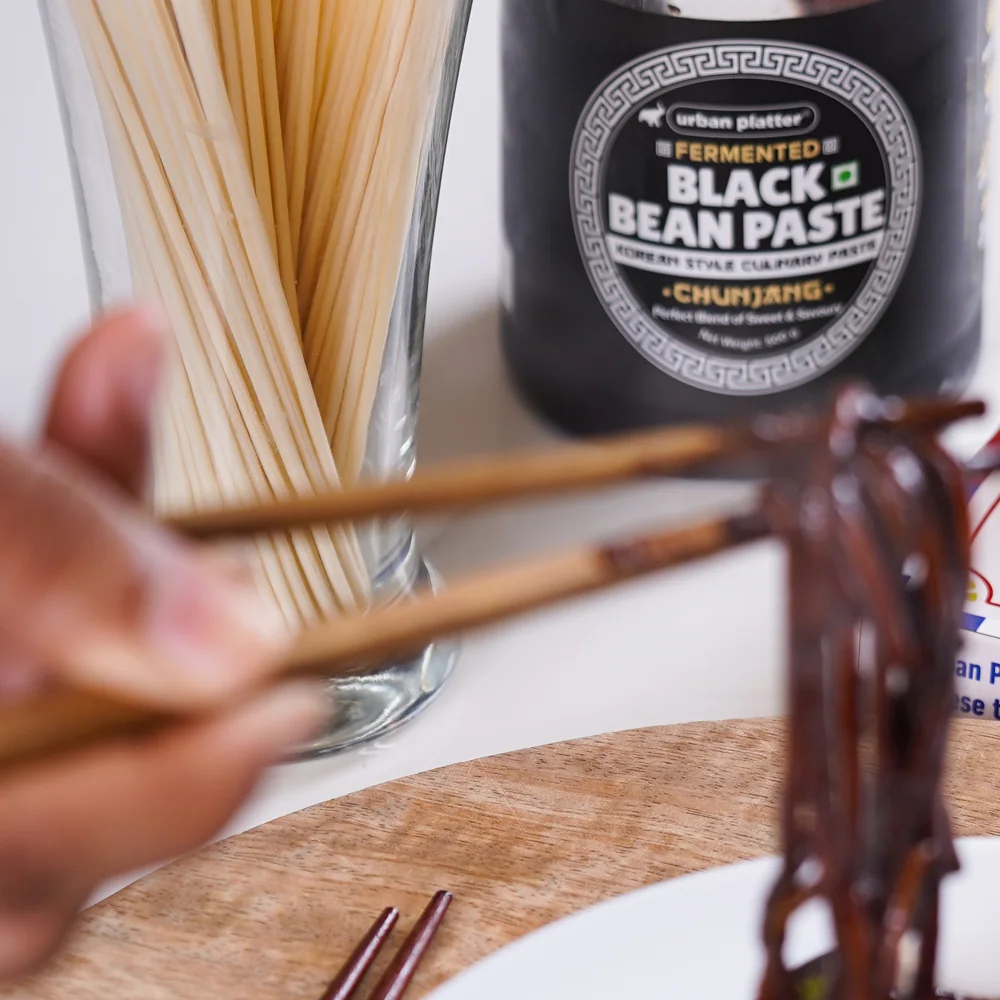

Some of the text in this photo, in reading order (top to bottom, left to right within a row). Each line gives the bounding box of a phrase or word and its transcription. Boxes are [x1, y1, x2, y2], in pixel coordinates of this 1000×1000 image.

[675, 111, 732, 130] urban
[674, 139, 821, 163] FERMENTED
[667, 163, 828, 208] BLACK
[608, 189, 885, 249] BEAN PASTE
[615, 240, 876, 272] KOREAN STYLE CULINARY PASTE
